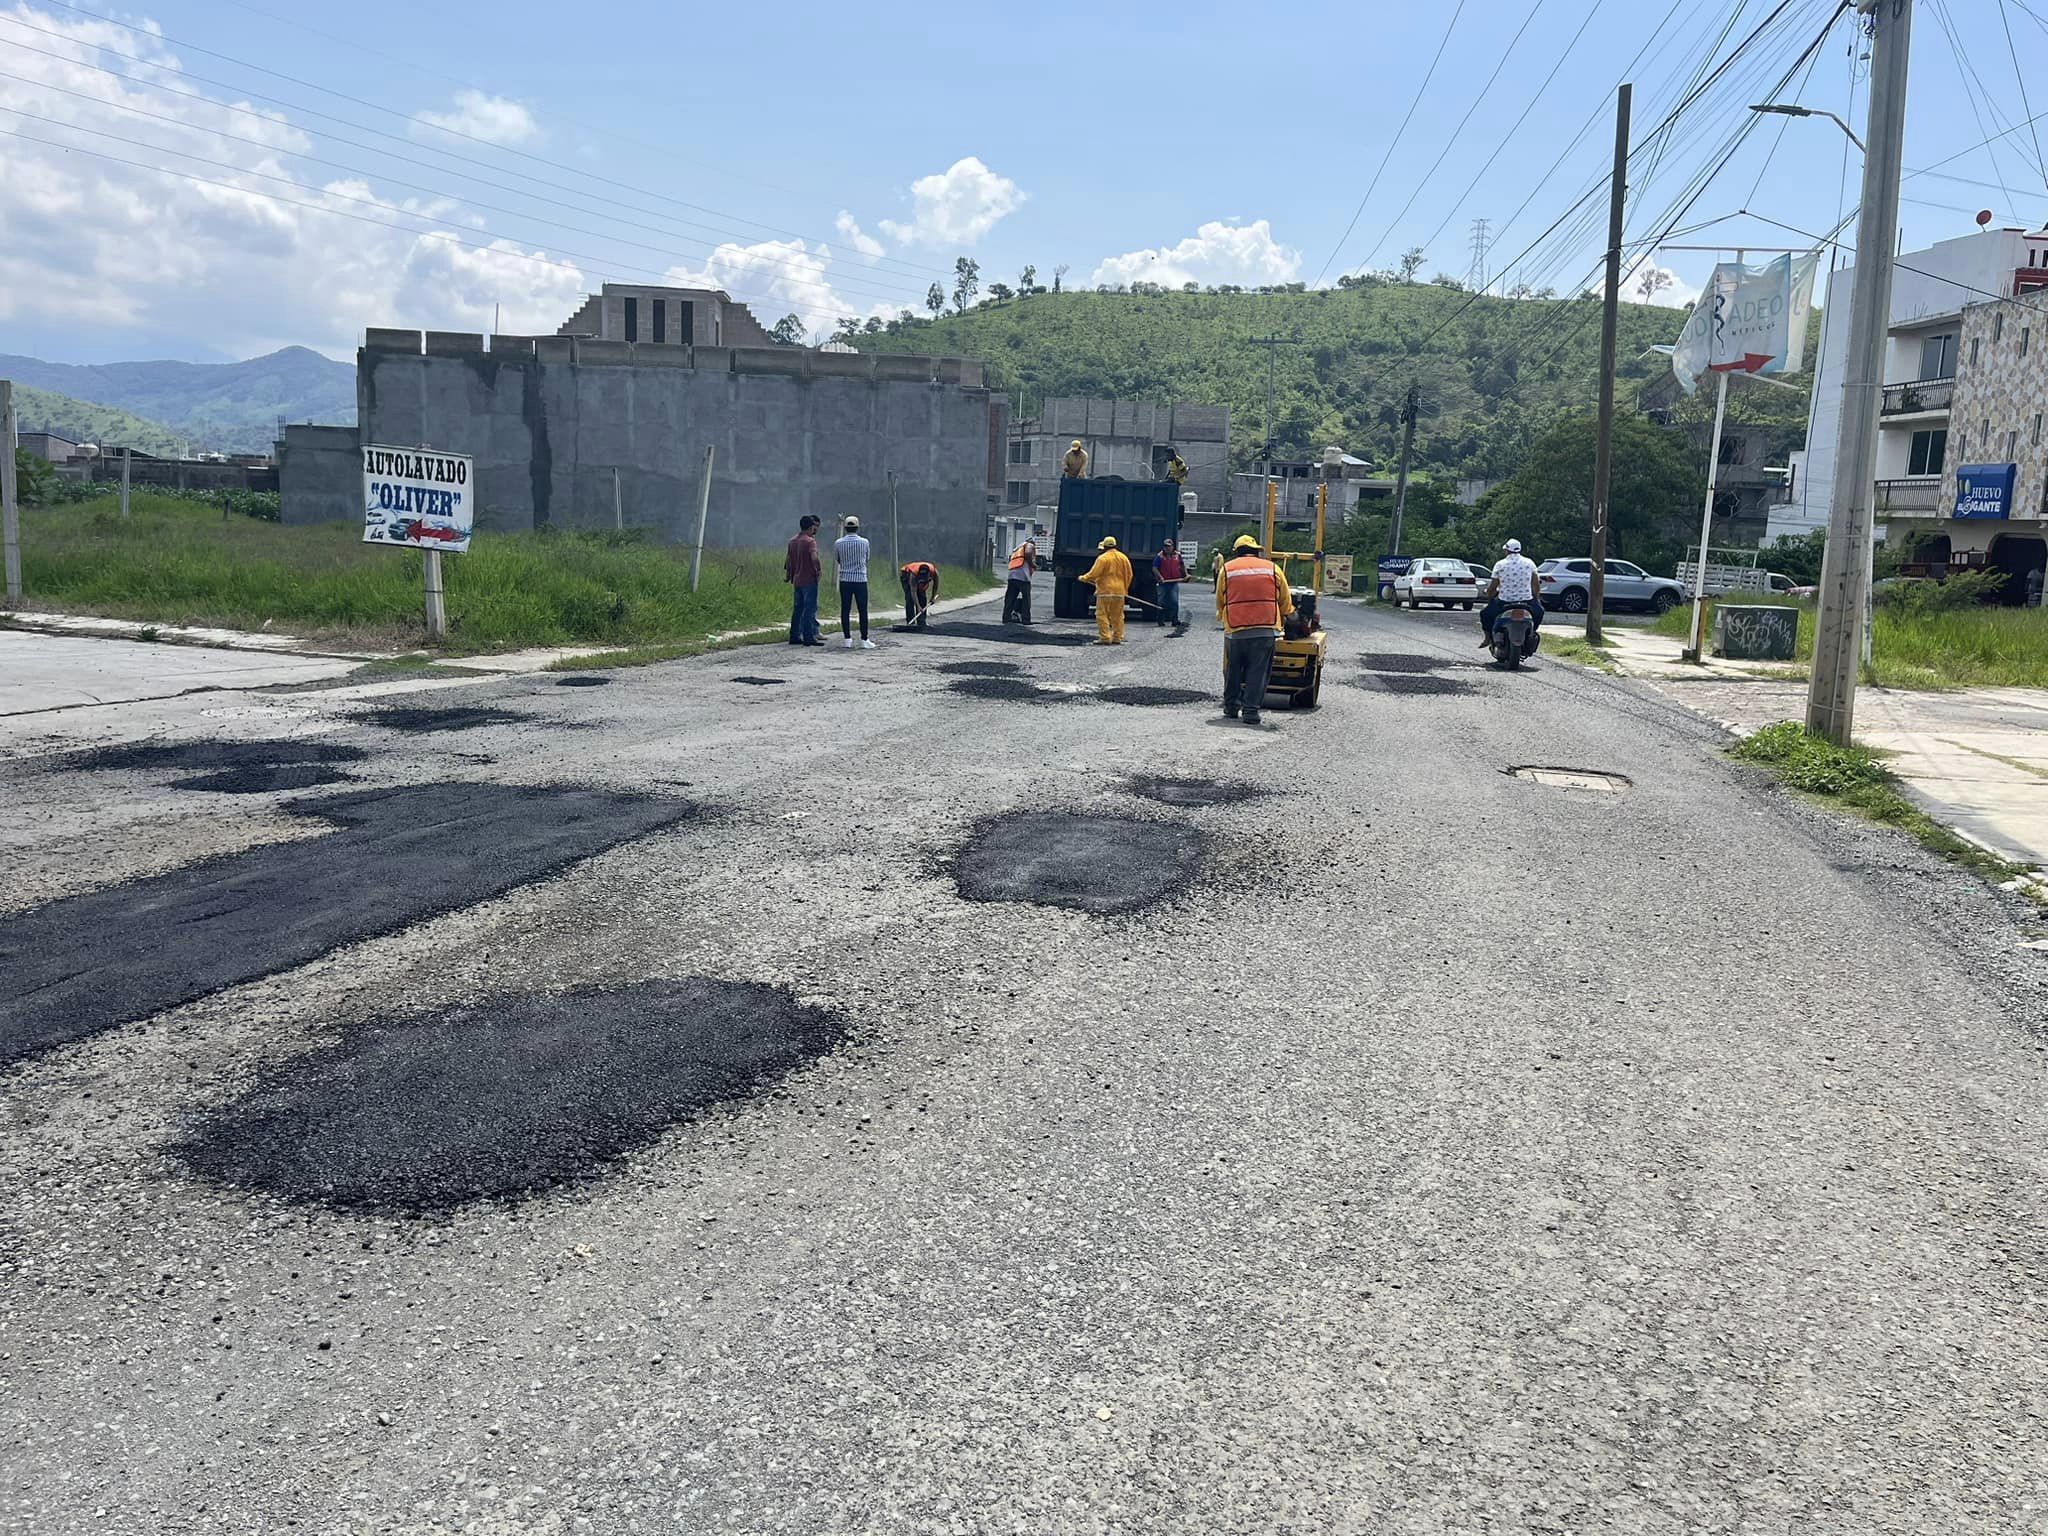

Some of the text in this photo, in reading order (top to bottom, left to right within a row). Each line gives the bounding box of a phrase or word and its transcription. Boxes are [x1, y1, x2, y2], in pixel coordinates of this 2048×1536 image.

[366, 450, 467, 485] AUTOLAVADO
[371, 482, 462, 517] "OLIVER"
[1961, 495, 2001, 515] GIGANTE
[1972, 487, 2002, 499] HUEVO
